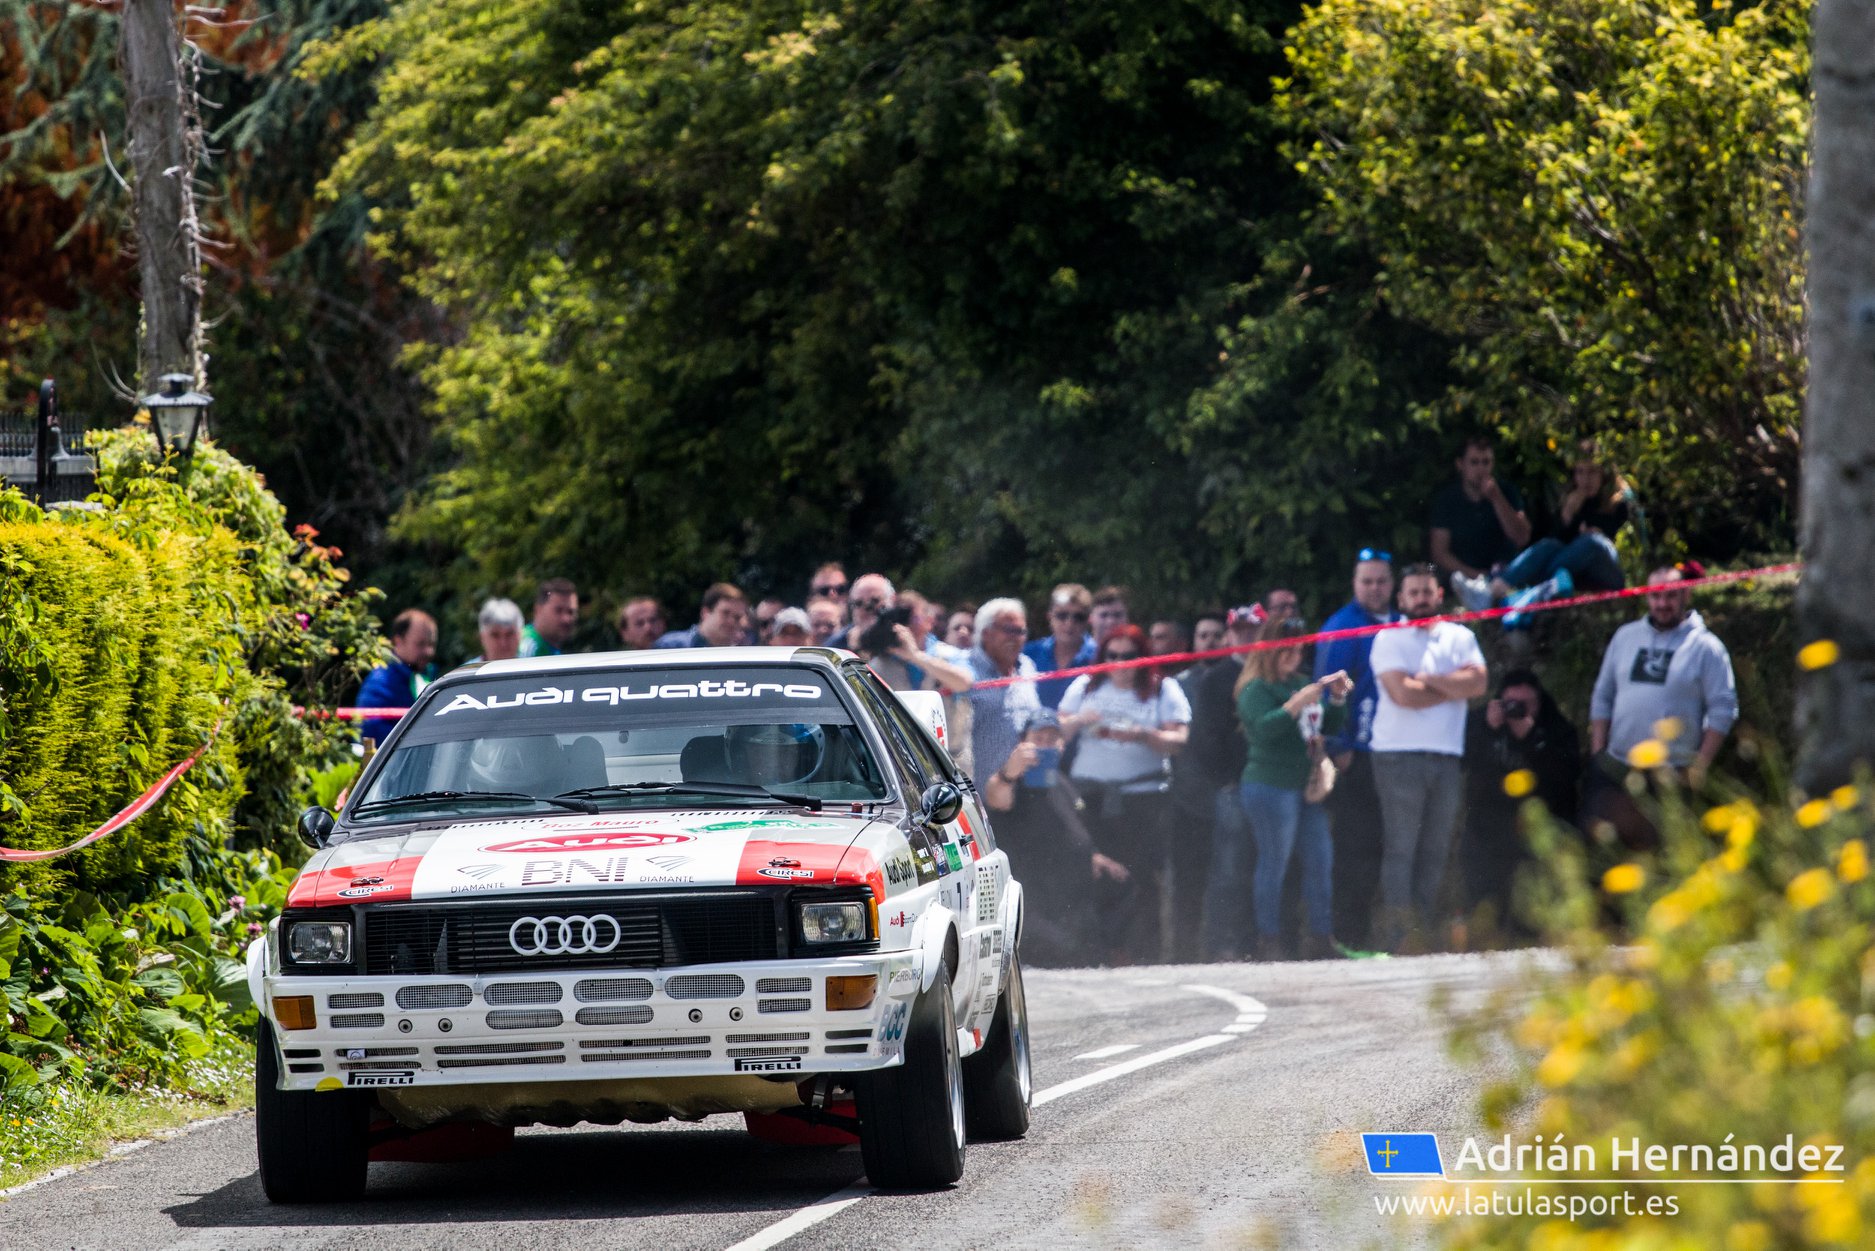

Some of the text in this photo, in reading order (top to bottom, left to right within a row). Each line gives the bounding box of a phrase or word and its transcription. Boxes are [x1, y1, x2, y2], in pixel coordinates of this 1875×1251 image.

[433, 679, 822, 717] Audi quattro
[521, 856, 629, 886] BNI
[639, 874, 694, 883] DIAMANTE
[450, 880, 506, 894] DIAMANTE
[877, 1001, 907, 1042] BCC
[733, 1055, 802, 1072] PIRELLI
[347, 1070, 415, 1086] PIRELLI
